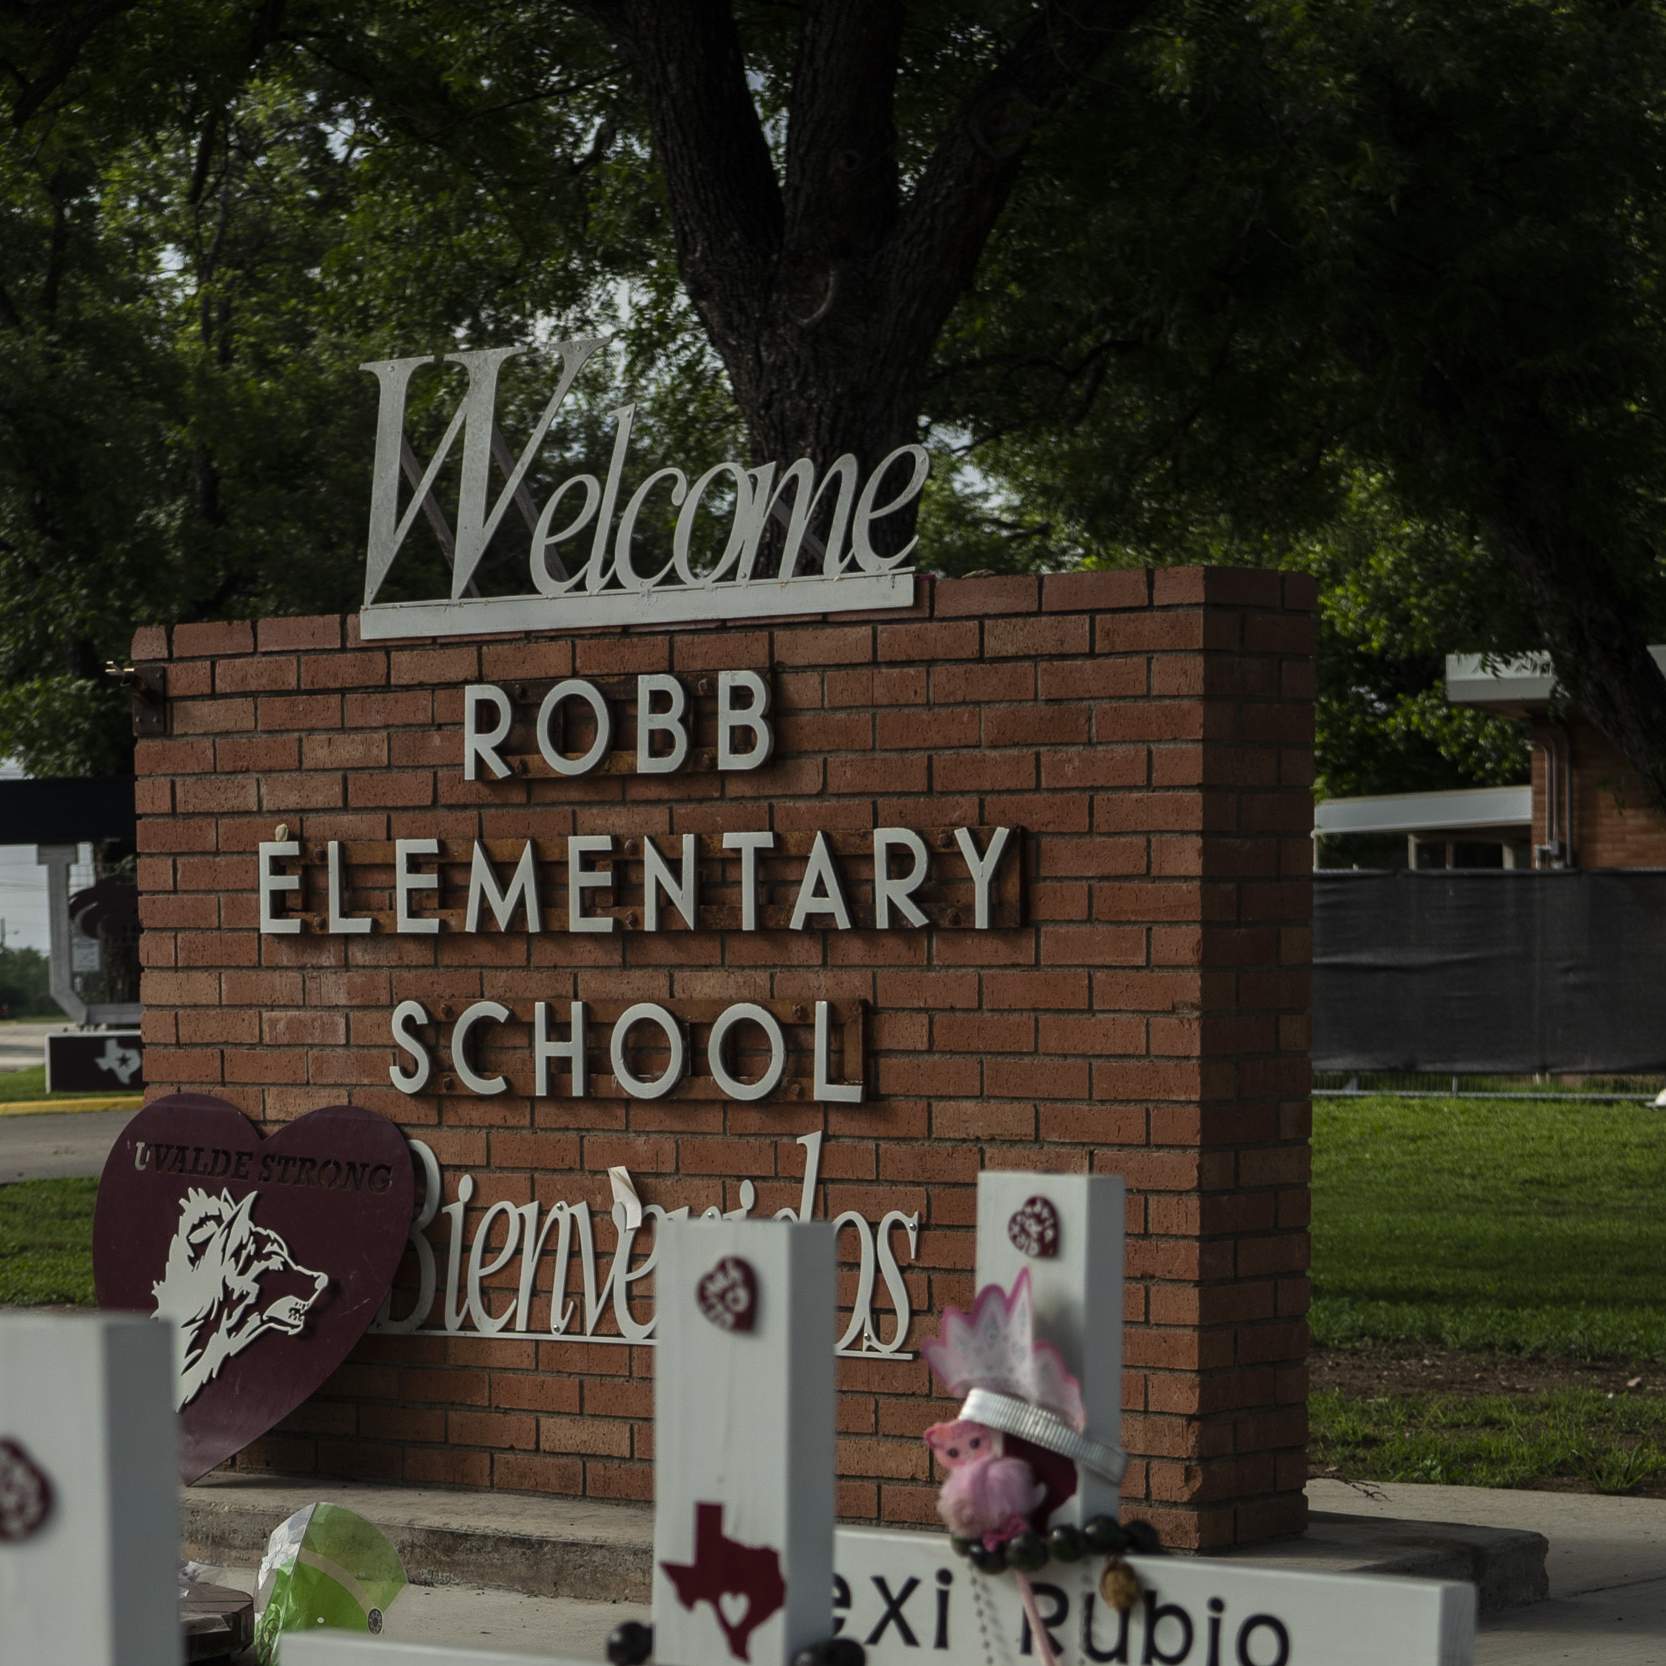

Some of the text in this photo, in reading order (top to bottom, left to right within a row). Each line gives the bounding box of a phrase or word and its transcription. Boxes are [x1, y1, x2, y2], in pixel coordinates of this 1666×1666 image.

[359, 335, 932, 606] Welcome
[463, 669, 775, 781] ROBB
[258, 826, 1012, 935] ELEMENTARY
[388, 999, 869, 1103] SCHOOL
[133, 1140, 393, 1194] UVALDE STRONG
